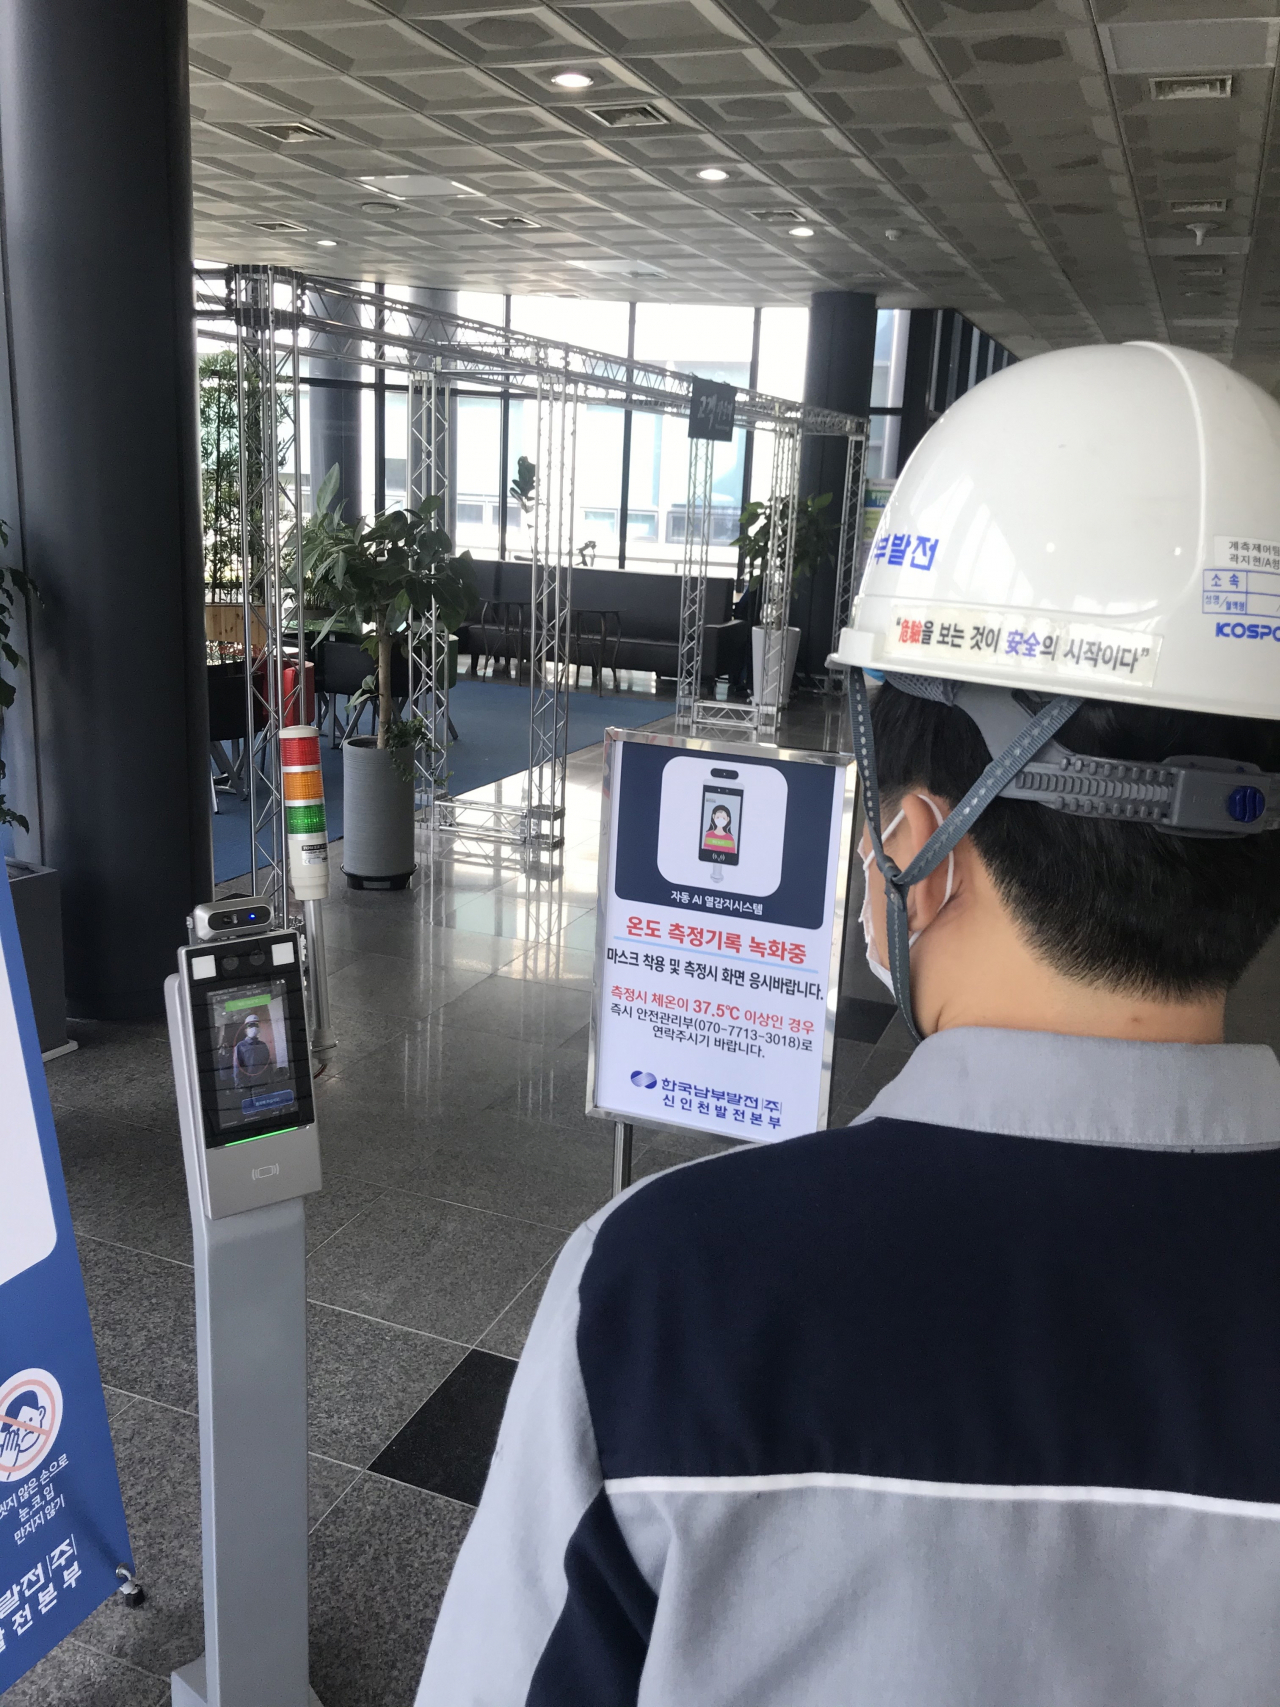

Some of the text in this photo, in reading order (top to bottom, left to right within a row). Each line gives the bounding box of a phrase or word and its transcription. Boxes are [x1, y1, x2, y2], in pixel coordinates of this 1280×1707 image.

[936, 623, 965, 649] 보는
[970, 624, 1001, 653] 것이
[1004, 629, 1060, 661] 安全의
[670, 890, 764, 915] 자동 AI 열감지시스템
[626, 916, 807, 964] 온도 측정기록 녹화중
[606, 947, 825, 1000] 마스크 착용 및 측정시 화면 응시바랍니다.
[610, 984, 648, 1004] 측정시
[651, 992, 690, 1012] 체온이
[744, 1009, 784, 1030] 이상인
[788, 1016, 815, 1035] 경우
[610, 1002, 633, 1018] 즉시
[652, 1024, 766, 1059] 연락주시기 바랍니다.
[18, 1477, 39, 1502] 않은
[40, 1453, 69, 1485] 손으로
[14, 1493, 65, 1546] 만지지 않기
